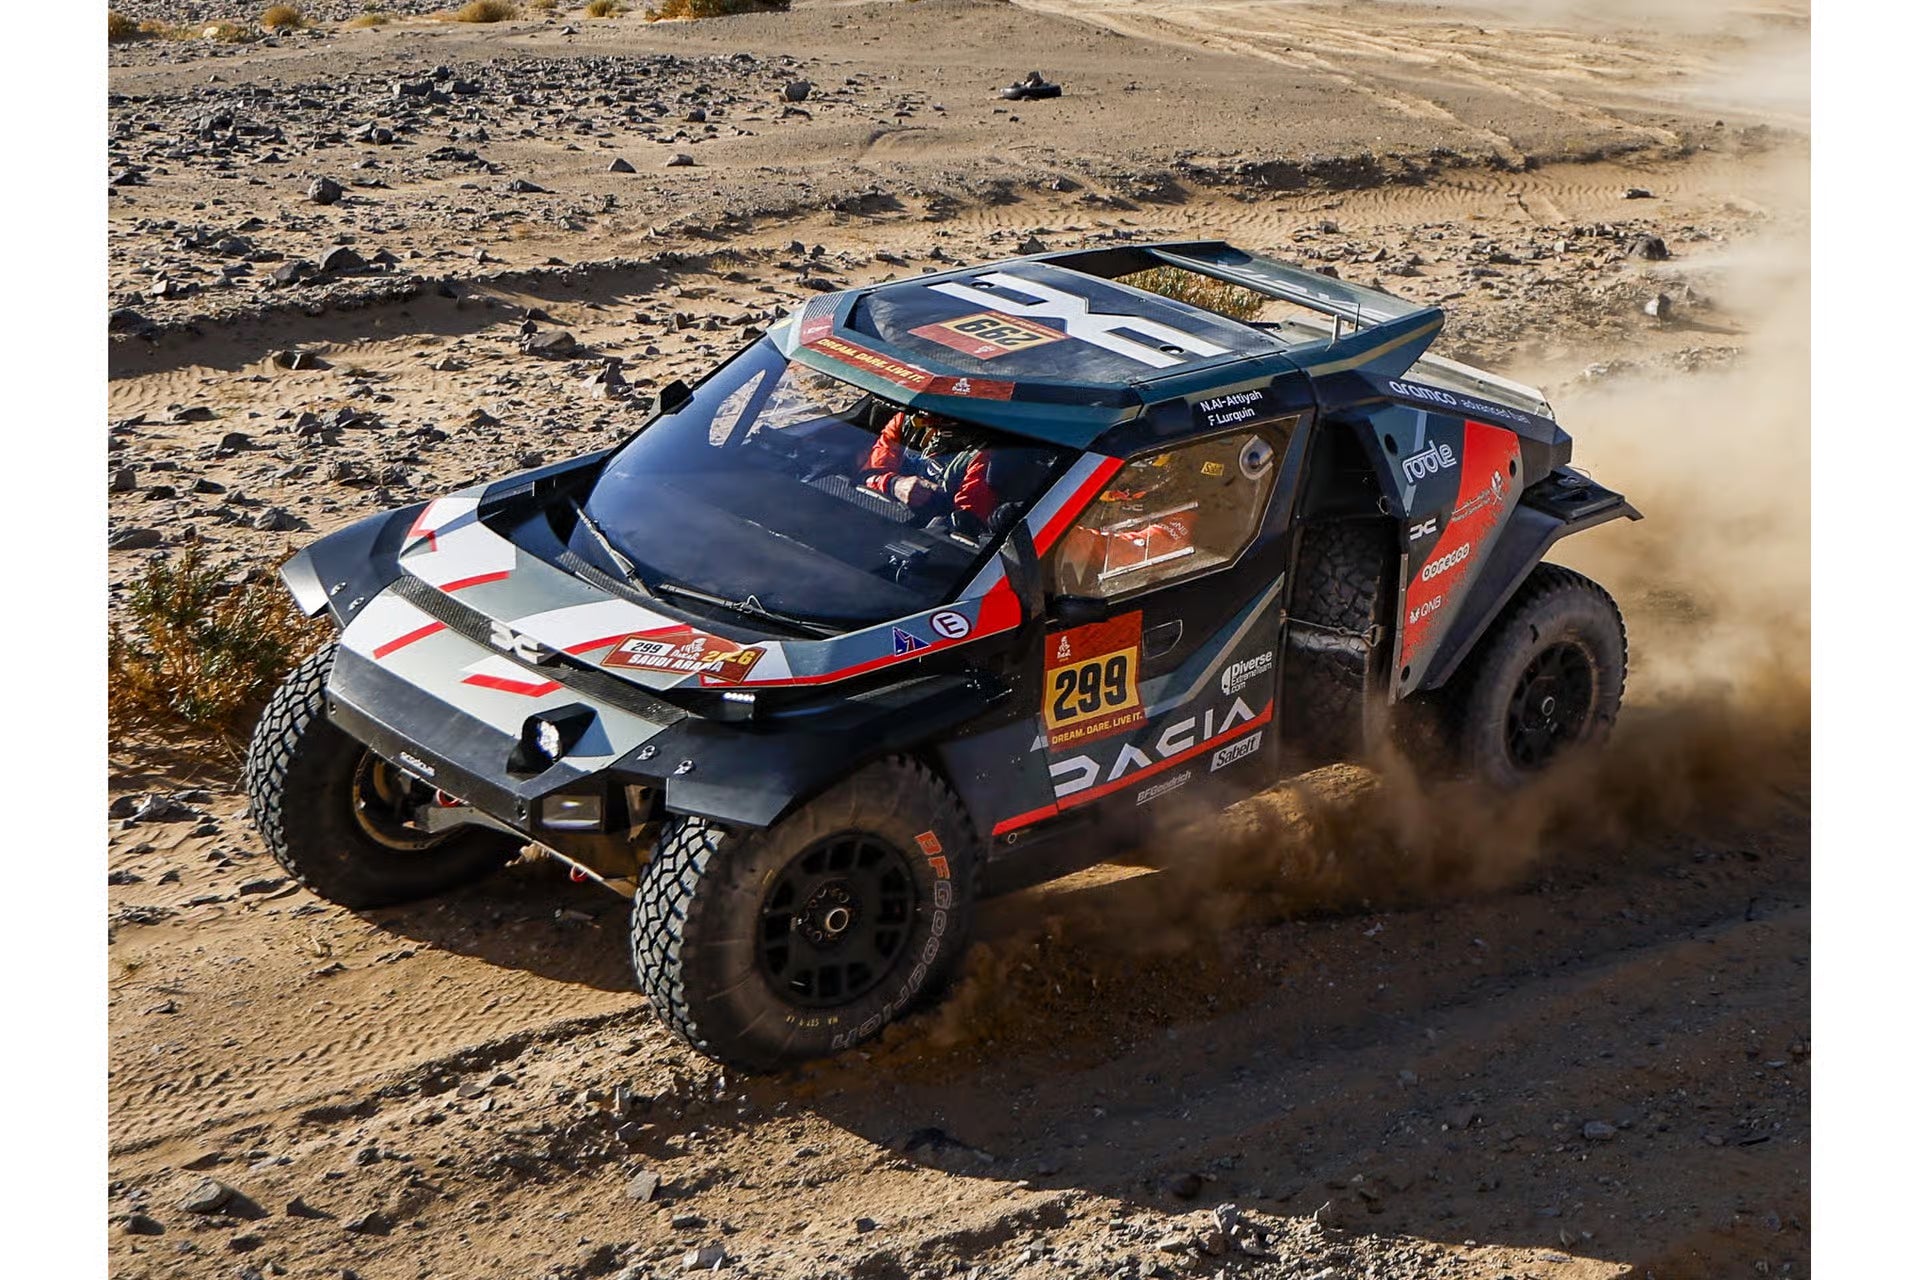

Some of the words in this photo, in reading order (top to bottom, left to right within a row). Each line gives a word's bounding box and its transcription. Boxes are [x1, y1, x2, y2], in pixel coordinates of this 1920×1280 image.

[954, 318, 1044, 346] 299
[884, 361, 911, 378] LIVE
[1200, 390, 1263, 412] N.Al-Attiyah
[1388, 380, 1457, 406] aramco
[1215, 407, 1256, 424] Lurquin
[1422, 543, 1469, 582] ooredoo
[1421, 595, 1441, 617] QNB
[936, 615, 965, 636] E
[628, 653, 673, 669] SAUDI
[630, 641, 663, 655] 299
[1231, 651, 1273, 677] Diverse
[1053, 655, 1127, 722] 299
[1051, 728, 1085, 745] DREAM.
[1086, 720, 1112, 736] DARE.
[1112, 713, 1133, 727] LIVE
[1131, 711, 1143, 721] IT.
[1049, 696, 1256, 798] DACIA
[1215, 736, 1257, 768] Sabelt
